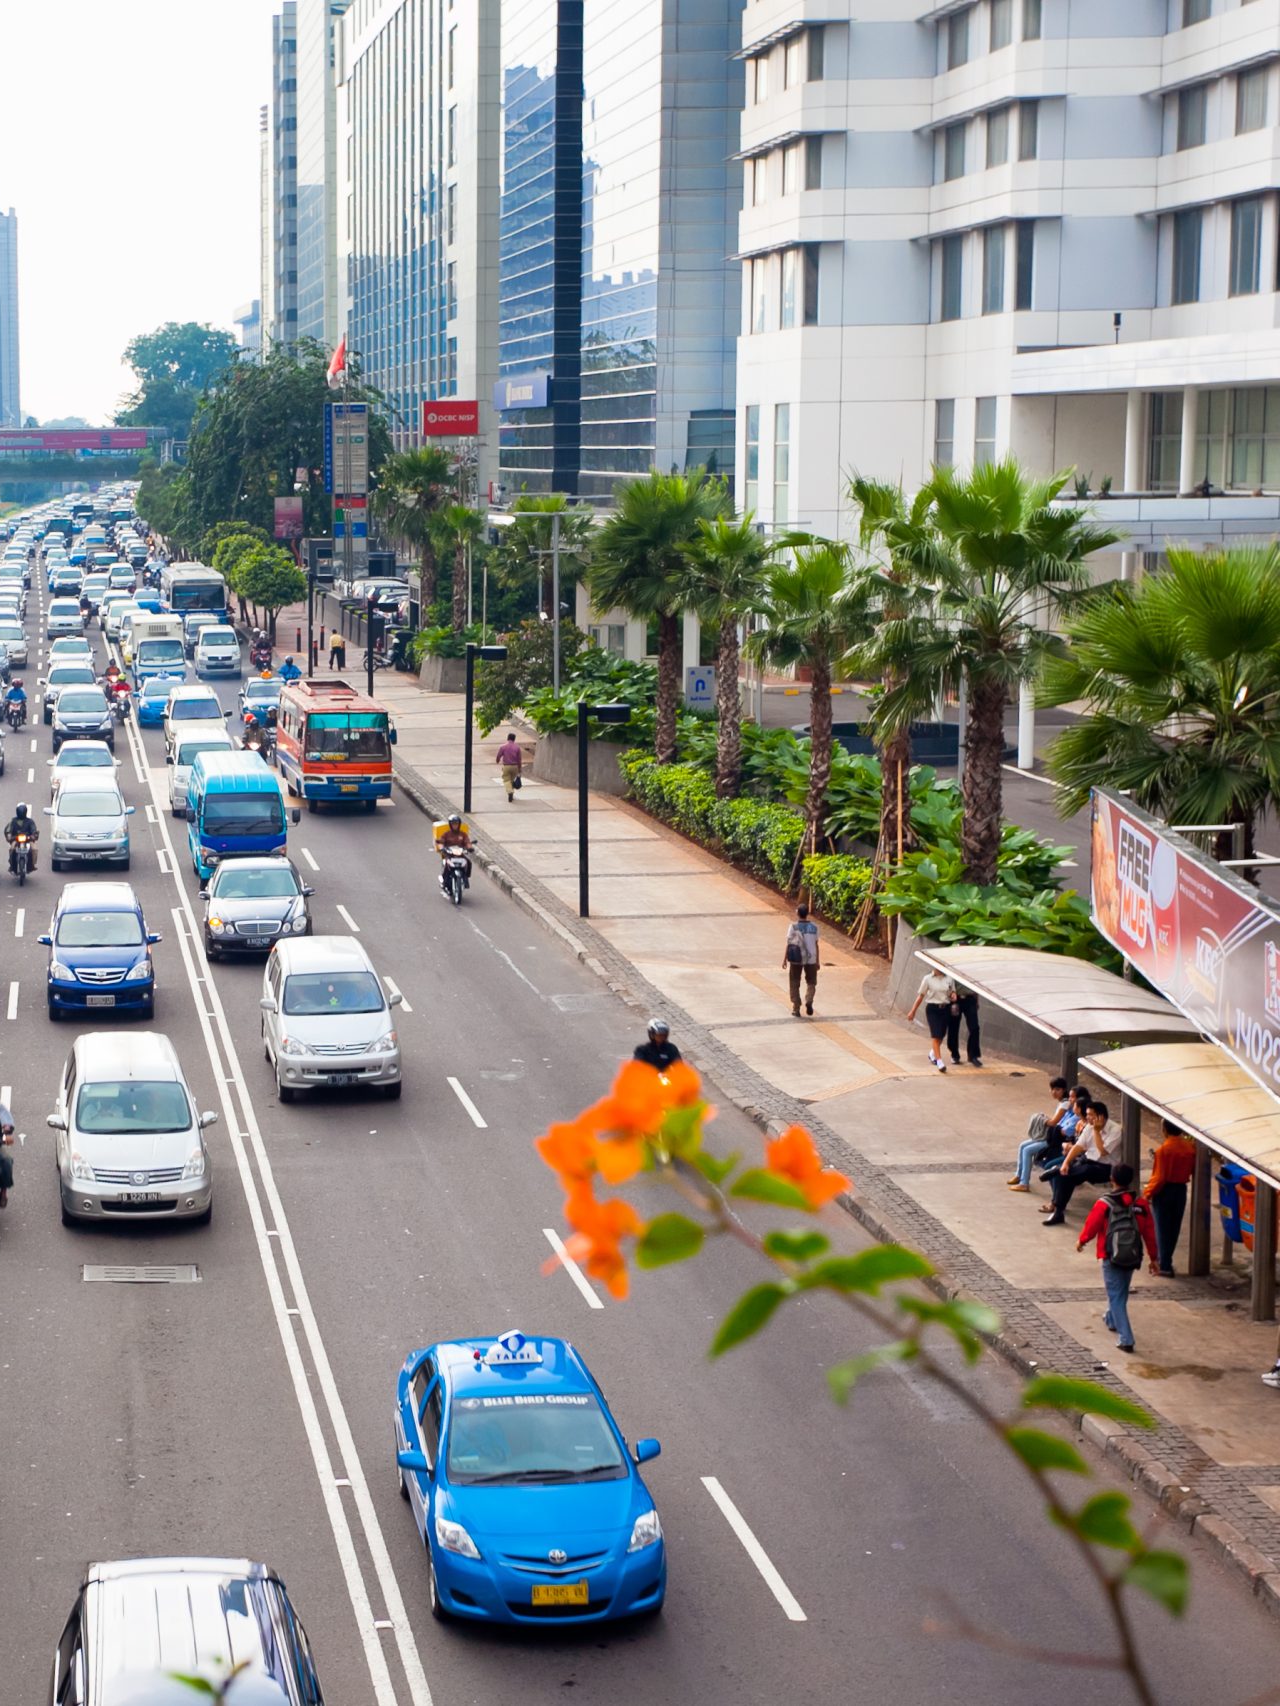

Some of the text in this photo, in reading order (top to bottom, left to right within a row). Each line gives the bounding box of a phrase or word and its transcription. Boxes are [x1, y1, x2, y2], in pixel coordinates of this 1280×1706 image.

[437, 414, 457, 422] OCBC
[1119, 827, 1150, 893] FREE
[1121, 886, 1147, 941] MUG
[1196, 936, 1218, 984] KFC
[496, 1353, 531, 1361] TAKSI
[482, 1395, 588, 1407] BLUE BIRD GROUP
